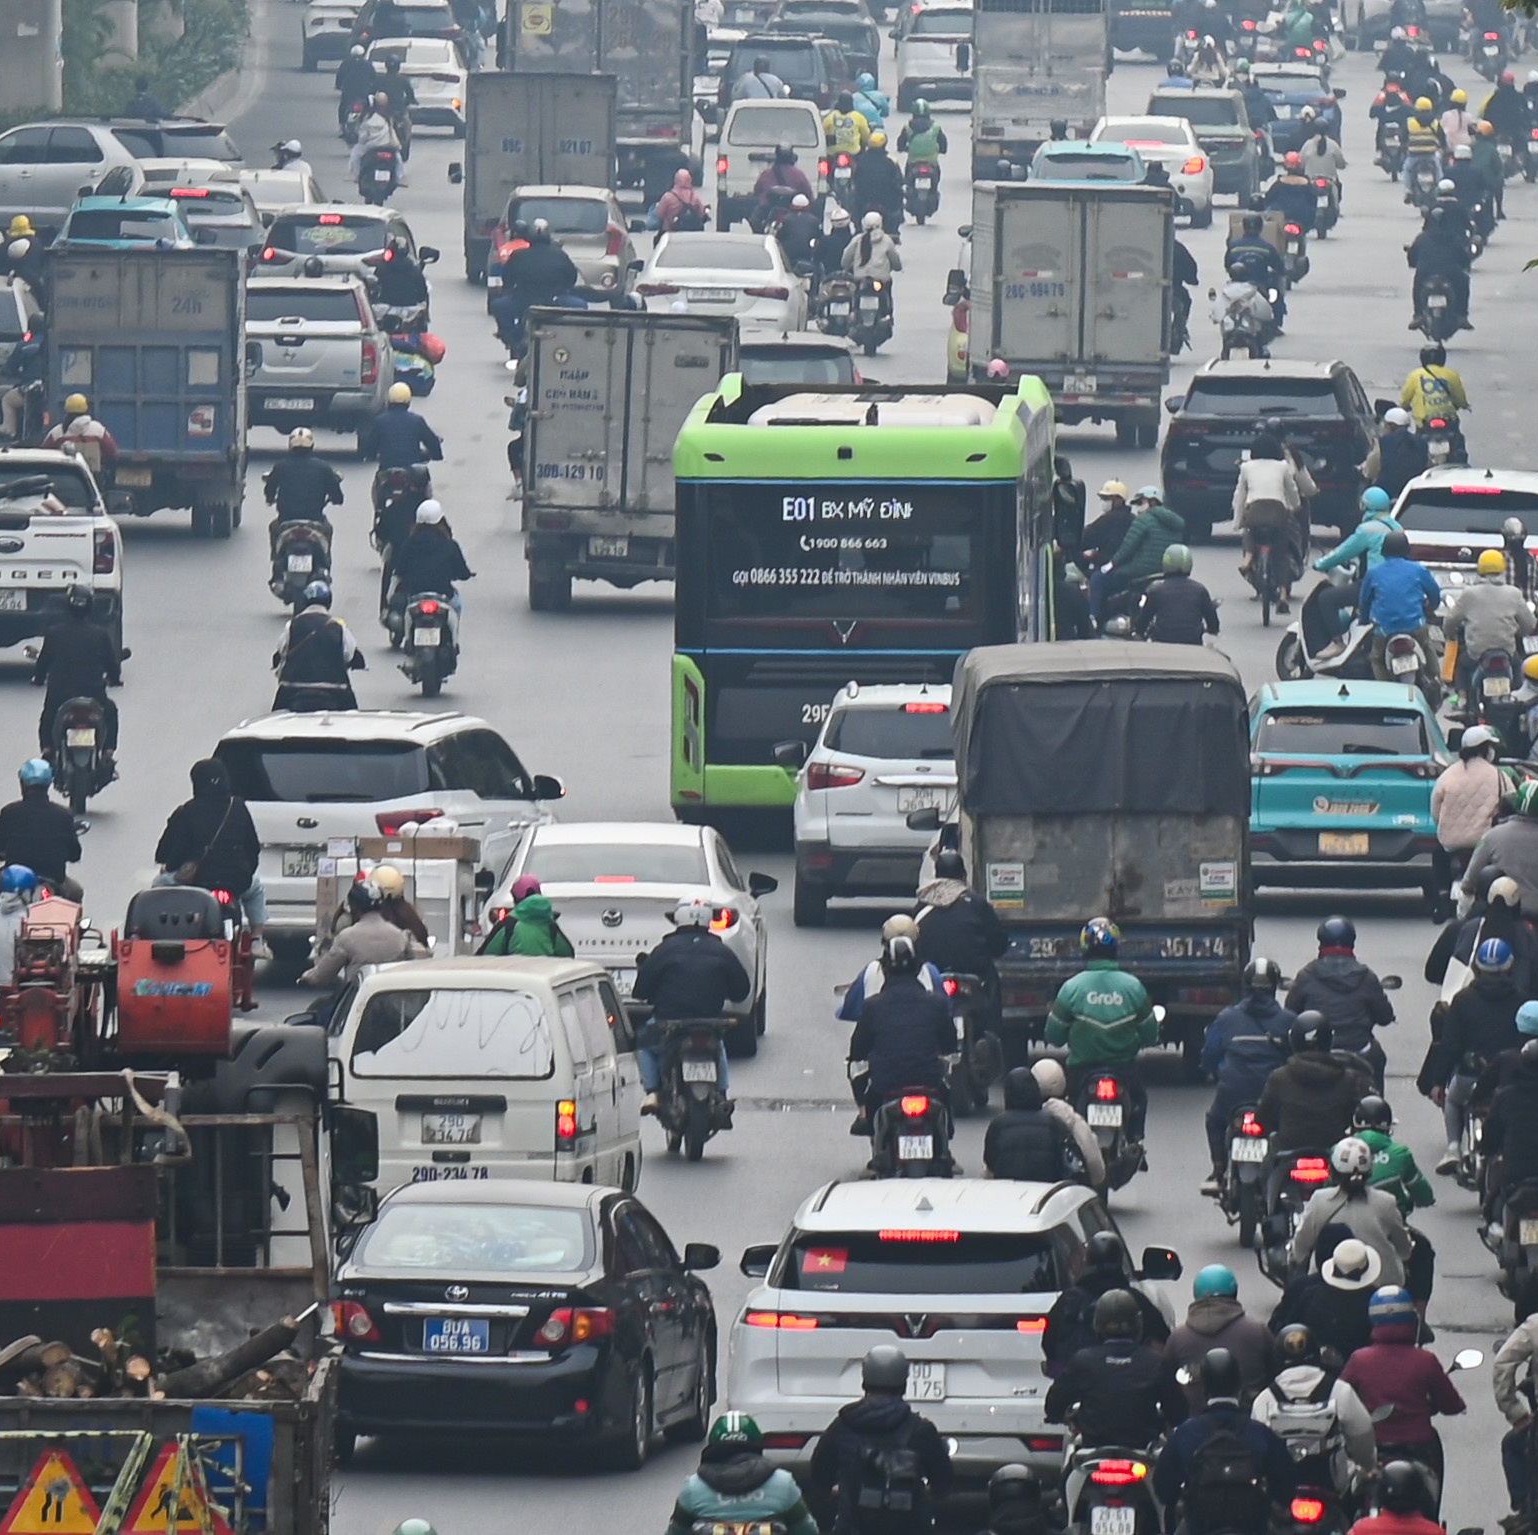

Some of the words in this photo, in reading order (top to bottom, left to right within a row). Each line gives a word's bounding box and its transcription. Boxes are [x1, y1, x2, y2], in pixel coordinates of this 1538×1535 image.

[783, 497, 815, 521] E01
[822, 501, 844, 519] BX
[848, 497, 875, 519] MỸ
[809, 538, 838, 549] 1900
[840, 538, 862, 549] 866
[864, 538, 887, 549] 663
[751, 567, 777, 585] 0866
[779, 567, 798, 585] 355
[800, 567, 820, 585] 222
[1087, 991, 1123, 1005] Grab
[439, 1116, 464, 1128] 29D
[442, 1319, 470, 1333] 80A
[909, 1363, 932, 1380] 9D
